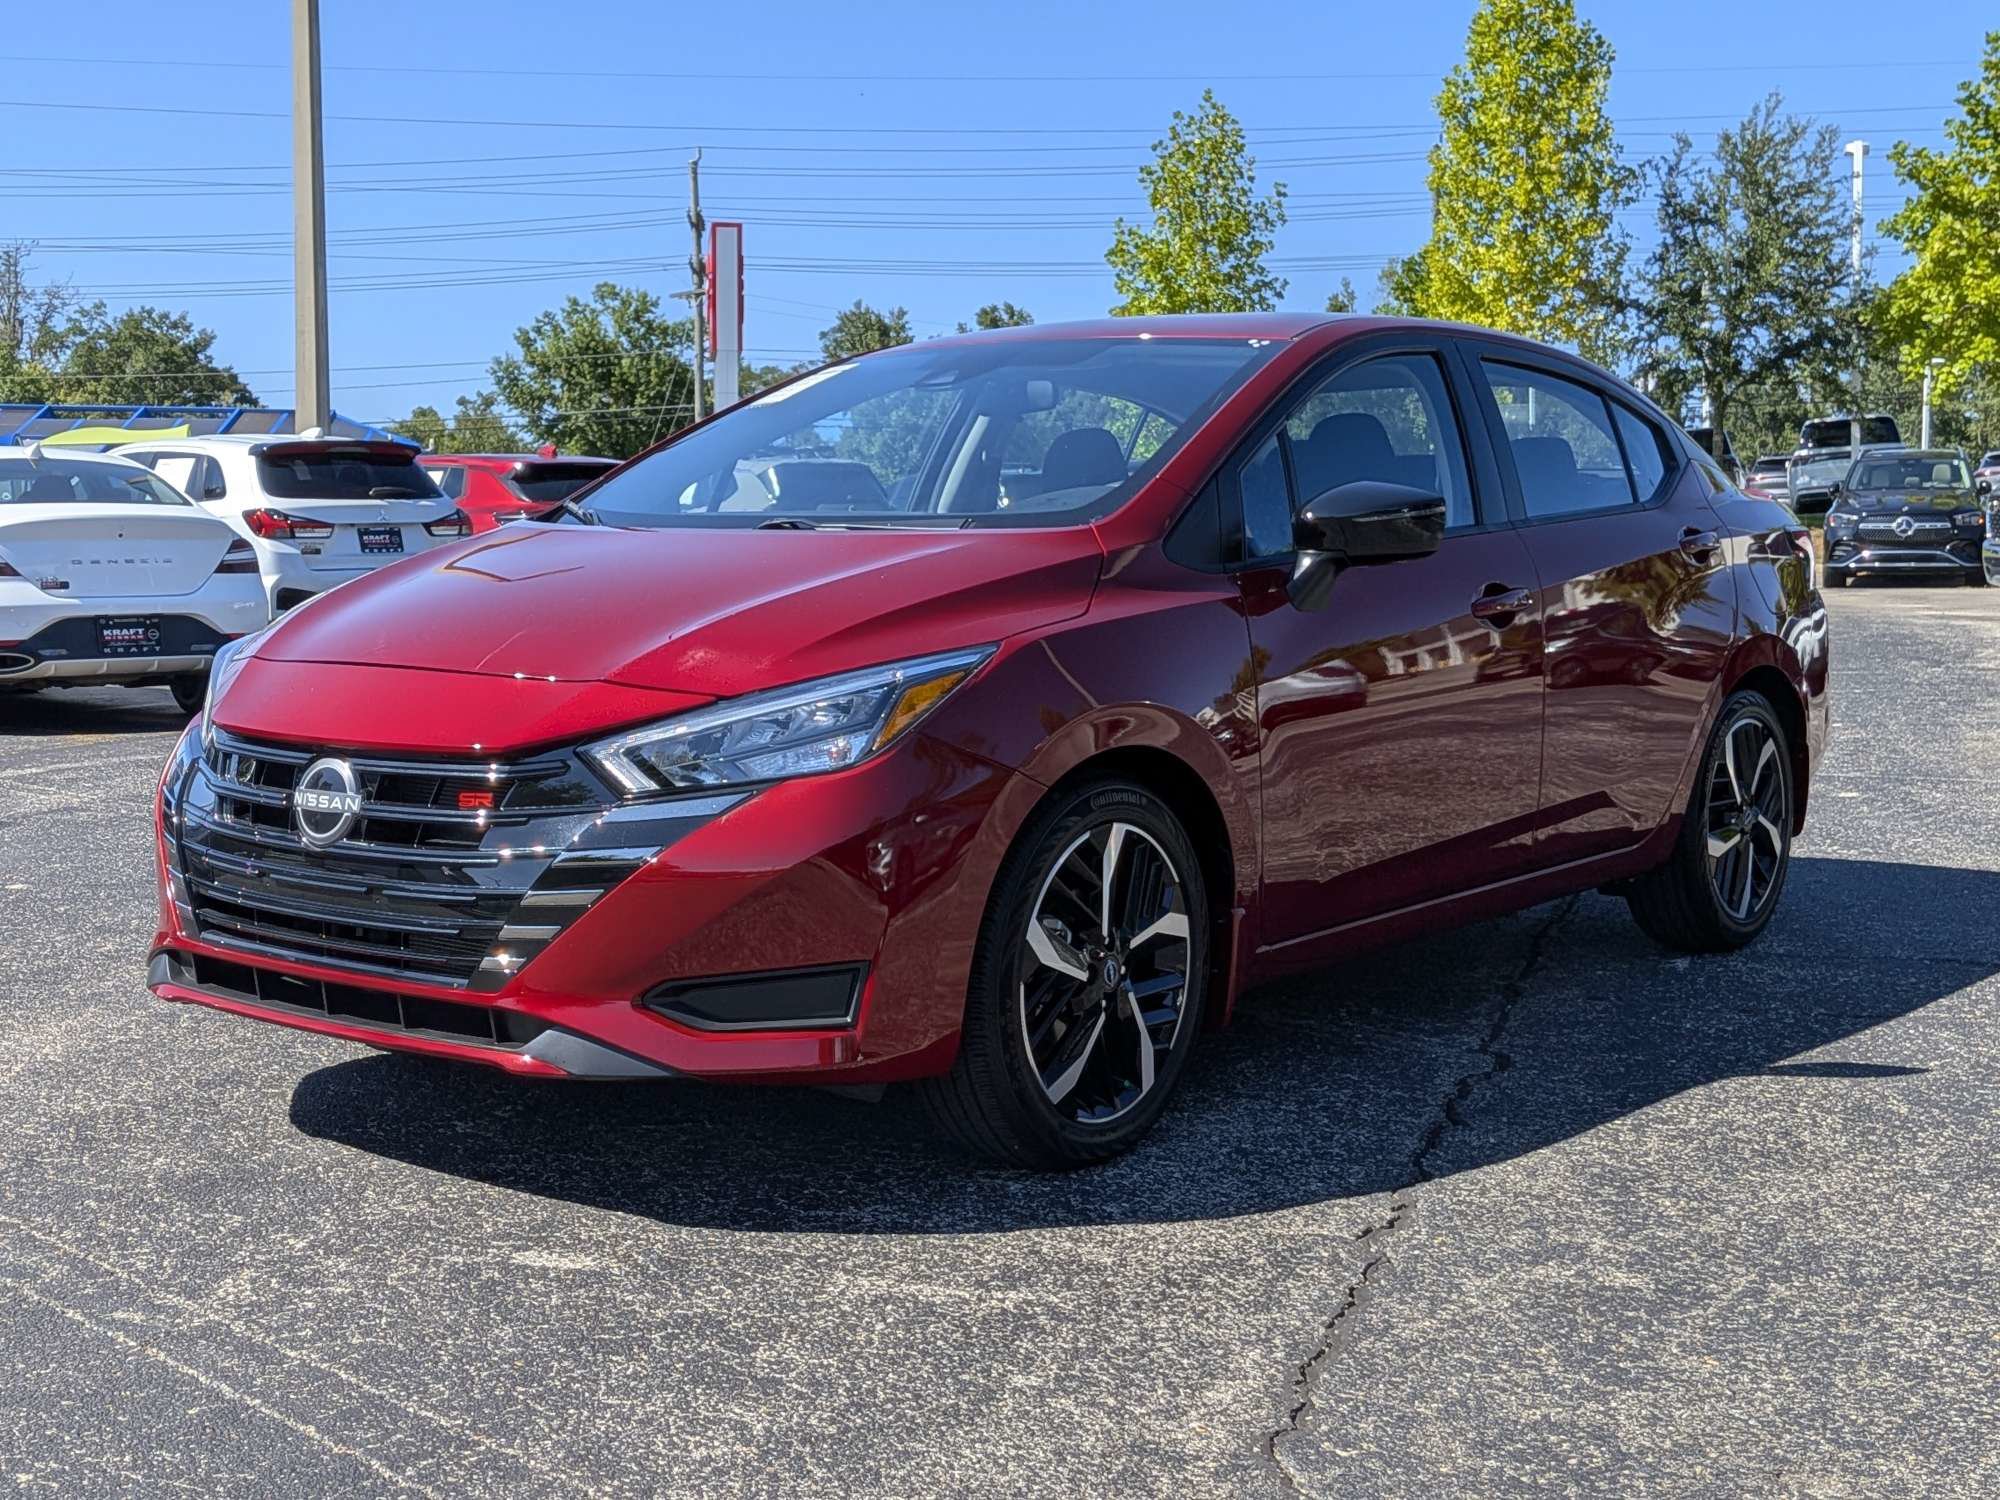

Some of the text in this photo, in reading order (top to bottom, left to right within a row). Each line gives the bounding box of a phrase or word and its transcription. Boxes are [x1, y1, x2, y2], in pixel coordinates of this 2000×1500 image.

[103, 628, 144, 636] KRAFT
[294, 791, 360, 811] NISSAN
[459, 792, 494, 808] SR
[1090, 791, 1140, 809] Continental
